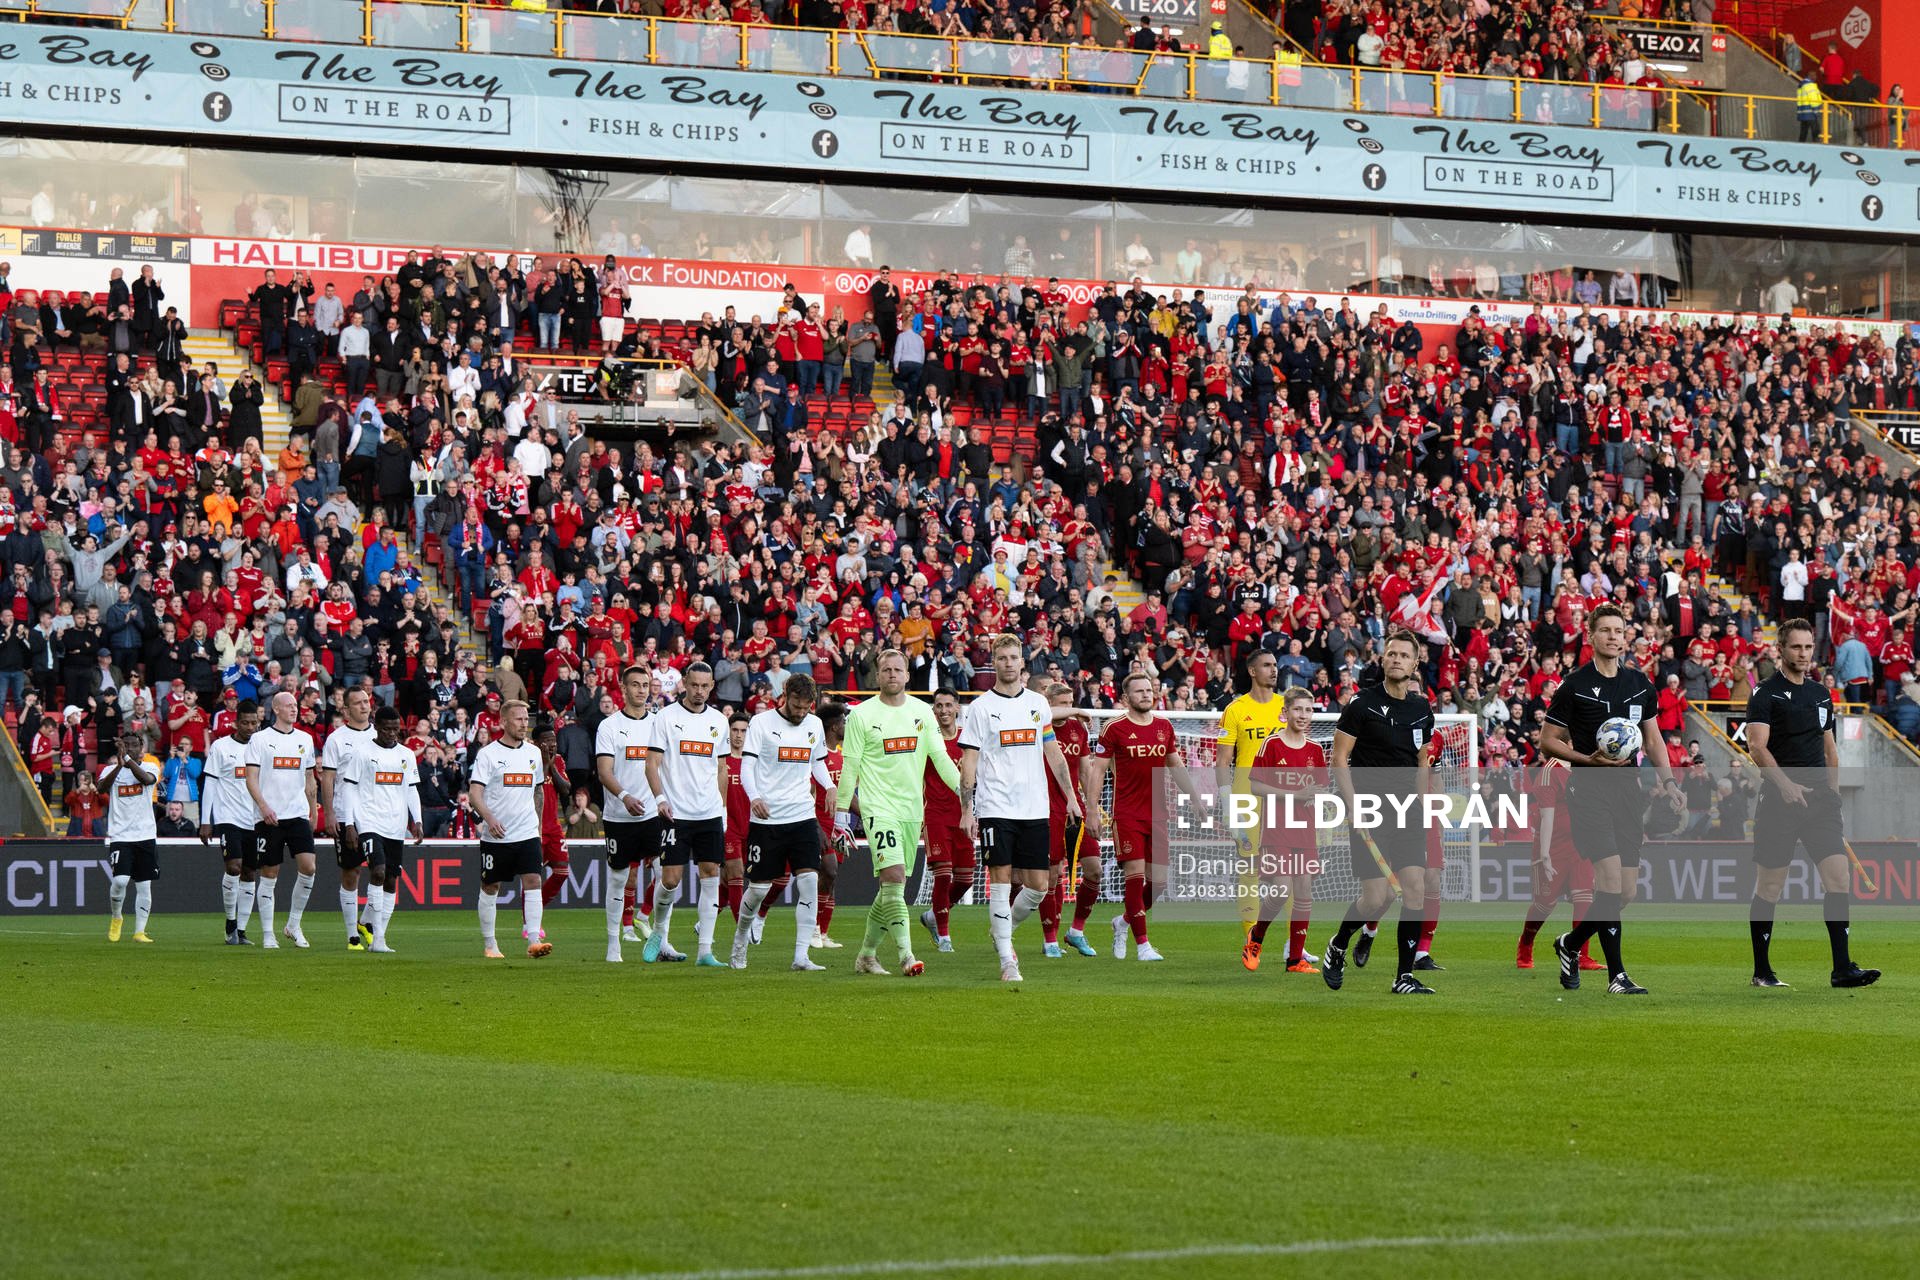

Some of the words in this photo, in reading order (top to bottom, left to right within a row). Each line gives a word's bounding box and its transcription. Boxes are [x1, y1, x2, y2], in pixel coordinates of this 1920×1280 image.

[1636, 34, 1684, 53] TEXO
[1711, 38, 1726, 49] 48
[39, 35, 154, 82] Bay
[275, 50, 376, 82] The
[392, 58, 503, 102] Bay
[22, 83, 38, 99] &
[48, 84, 121, 104] CHIPS
[548, 68, 645, 100] The
[661, 76, 768, 121] Bay
[292, 95, 328, 113] ON
[345, 98, 399, 117] THE
[416, 103, 493, 123] ROAD
[873, 90, 967, 121] The
[979, 97, 1081, 140] Bay
[589, 117, 641, 136] FISH
[650, 122, 665, 138] &
[672, 123, 739, 142] CHIPS
[1119, 106, 1210, 136] The
[1221, 113, 1320, 155] Bay
[892, 133, 926, 150] ON
[940, 136, 990, 154] THE
[1004, 140, 1073, 159] ROAD
[1412, 125, 1501, 155] The
[1509, 132, 1604, 173] Bay
[1160, 153, 1207, 171] FISH
[1215, 157, 1229, 172] &
[1236, 158, 1297, 176] CHIPS
[1636, 140, 1723, 169] The
[1730, 146, 1822, 187] Bay
[1435, 166, 1465, 183] ON
[1478, 169, 1523, 187] THE
[1536, 173, 1600, 191] ROAD
[1677, 185, 1720, 202] FISH
[1727, 190, 1739, 203] &
[1746, 190, 1802, 207] CHIPS
[56, 232, 82, 242] FOWLER
[131, 236, 157, 246] FOWLER
[662, 263, 787, 289] FOUNDATION
[1398, 308, 1424, 318] Stena
[1426, 310, 1457, 322] Drilling
[558, 373, 601, 393] TEX
[1899, 427, 1920, 444] TE
[887, 740, 915, 748] BRA
[1003, 732, 1036, 741] BRA
[682, 743, 711, 752] BRA
[781, 750, 809, 758] BRA
[1126, 744, 1167, 758] TEXO
[377, 774, 402, 782] BRA
[1275, 771, 1315, 787] TEXO
[660, 828, 677, 847] 24
[874, 829, 897, 850] 26
[982, 827, 995, 847] 11
[481, 853, 494, 870] 18
[1669, 858, 1738, 900] WE
